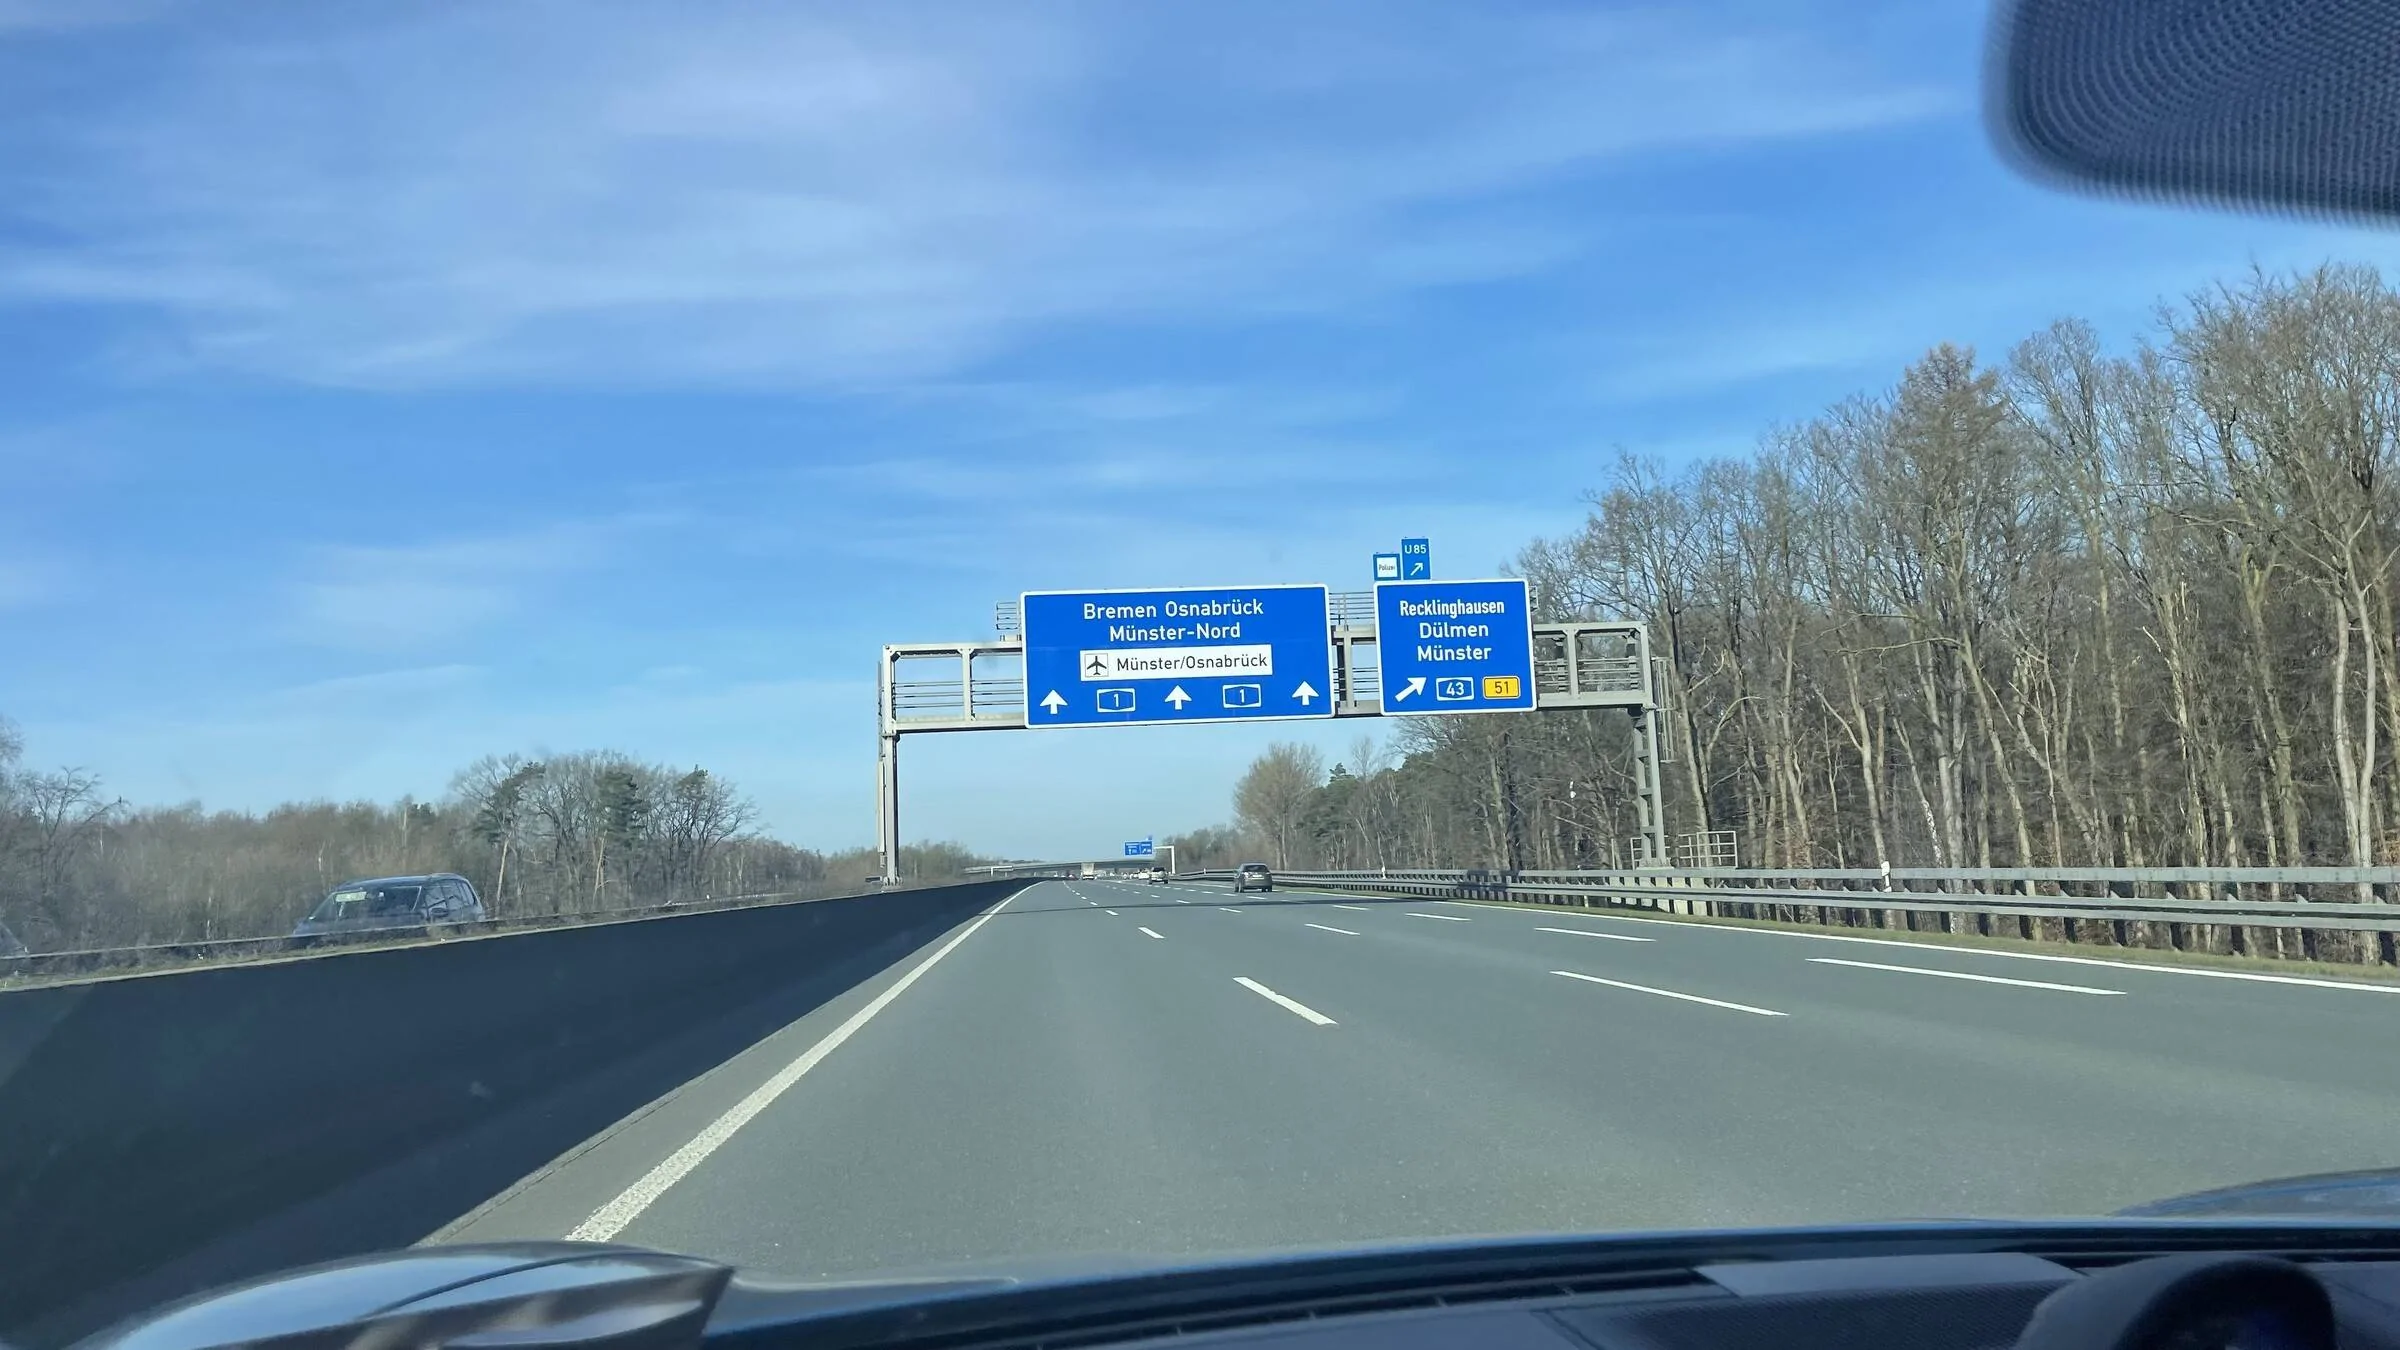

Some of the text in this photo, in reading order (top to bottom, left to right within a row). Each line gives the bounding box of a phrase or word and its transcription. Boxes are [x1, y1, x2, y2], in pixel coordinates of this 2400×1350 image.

[1083, 598, 1264, 620] Bremen Osnabrück
[1399, 598, 1505, 619] Recklinghausen
[1109, 622, 1241, 642] Münster-Nord
[1419, 622, 1489, 639] Dülmen
[1417, 645, 1492, 662] Münster
[1117, 653, 1268, 672] Münster/Osnabrück
[1239, 688, 1246, 704] 1
[1446, 682, 1465, 696] 43
[1494, 681, 1509, 695] 51
[1113, 693, 1120, 708] 1
